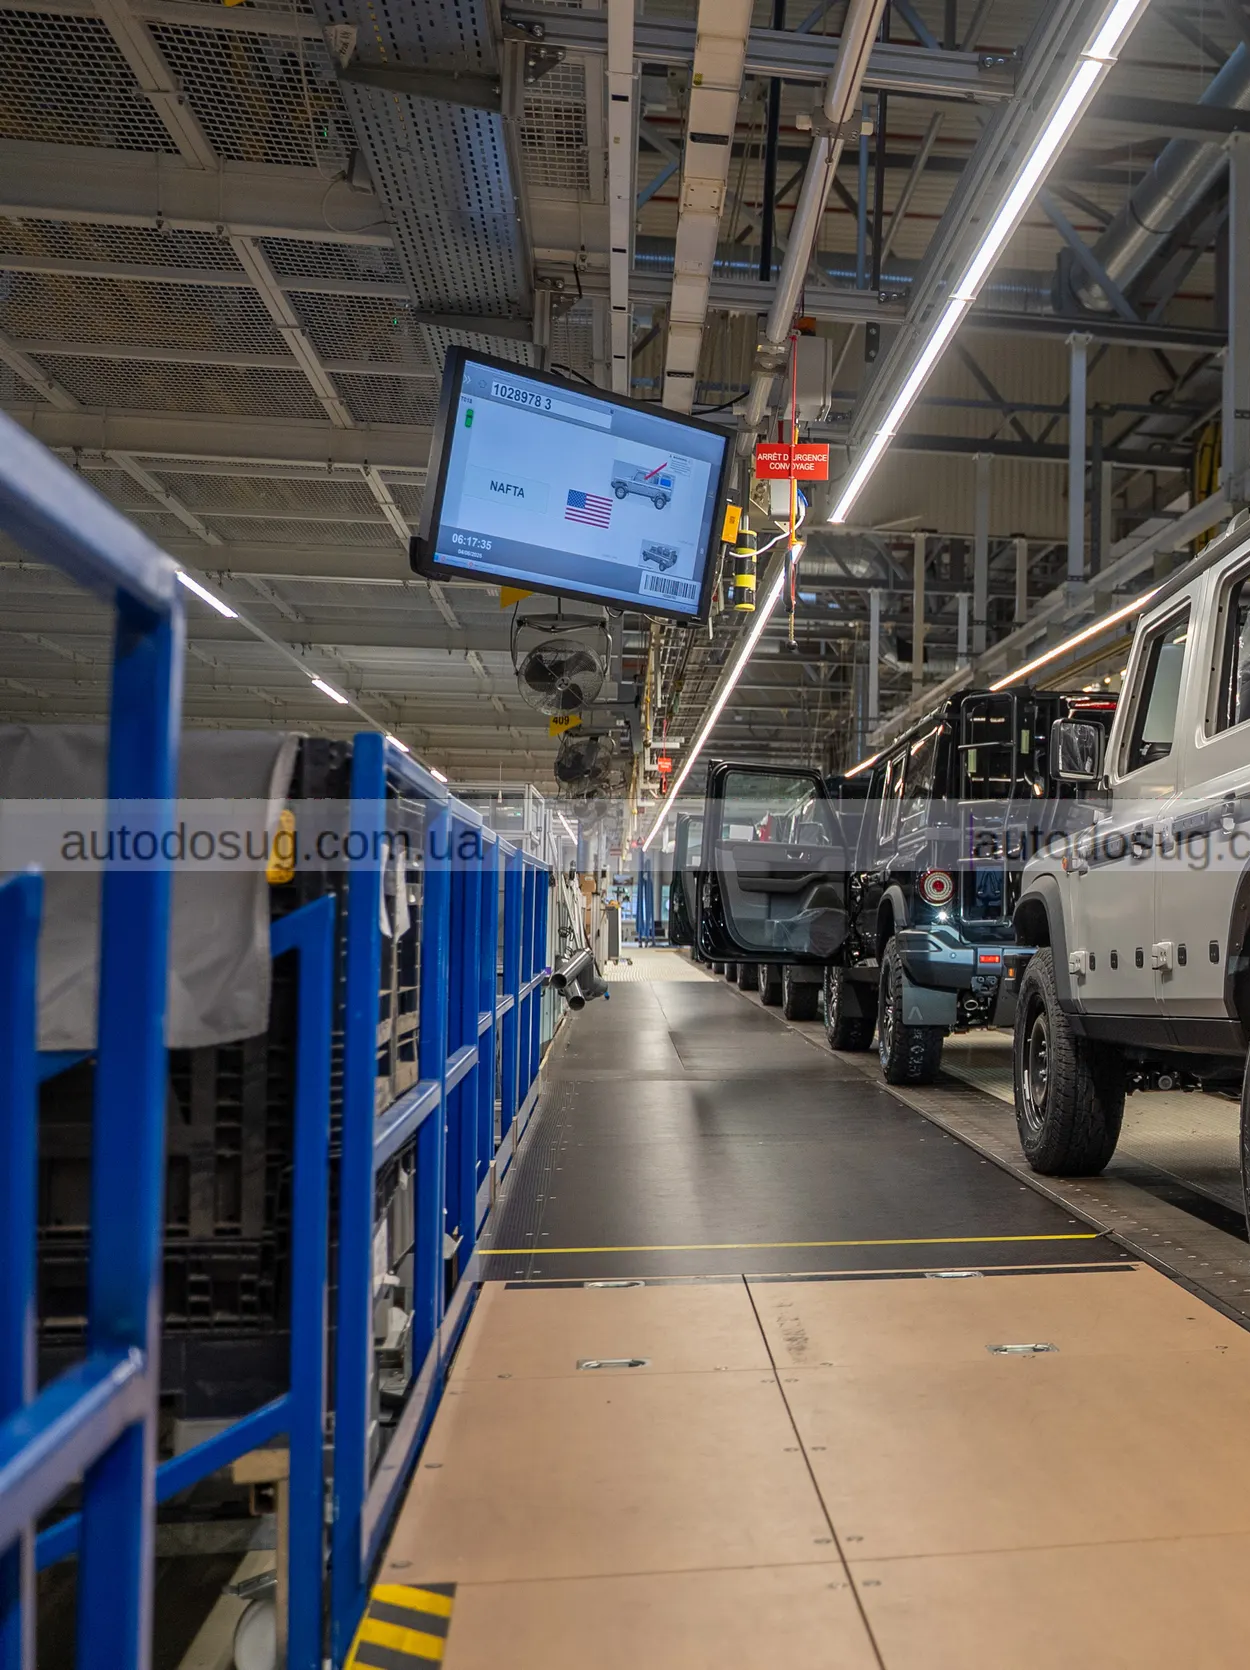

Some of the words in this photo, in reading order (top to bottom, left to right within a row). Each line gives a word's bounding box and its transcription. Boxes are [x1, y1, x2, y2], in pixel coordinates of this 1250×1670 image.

[493, 383, 542, 408] 1028978
[544, 397, 552, 410] 3
[757, 452, 782, 461] ARRÊT
[783, 453, 828, 462] DURGENCE
[489, 480, 525, 498] NAFTA
[451, 532, 493, 551] 06:17:35
[552, 715, 570, 726] 409
